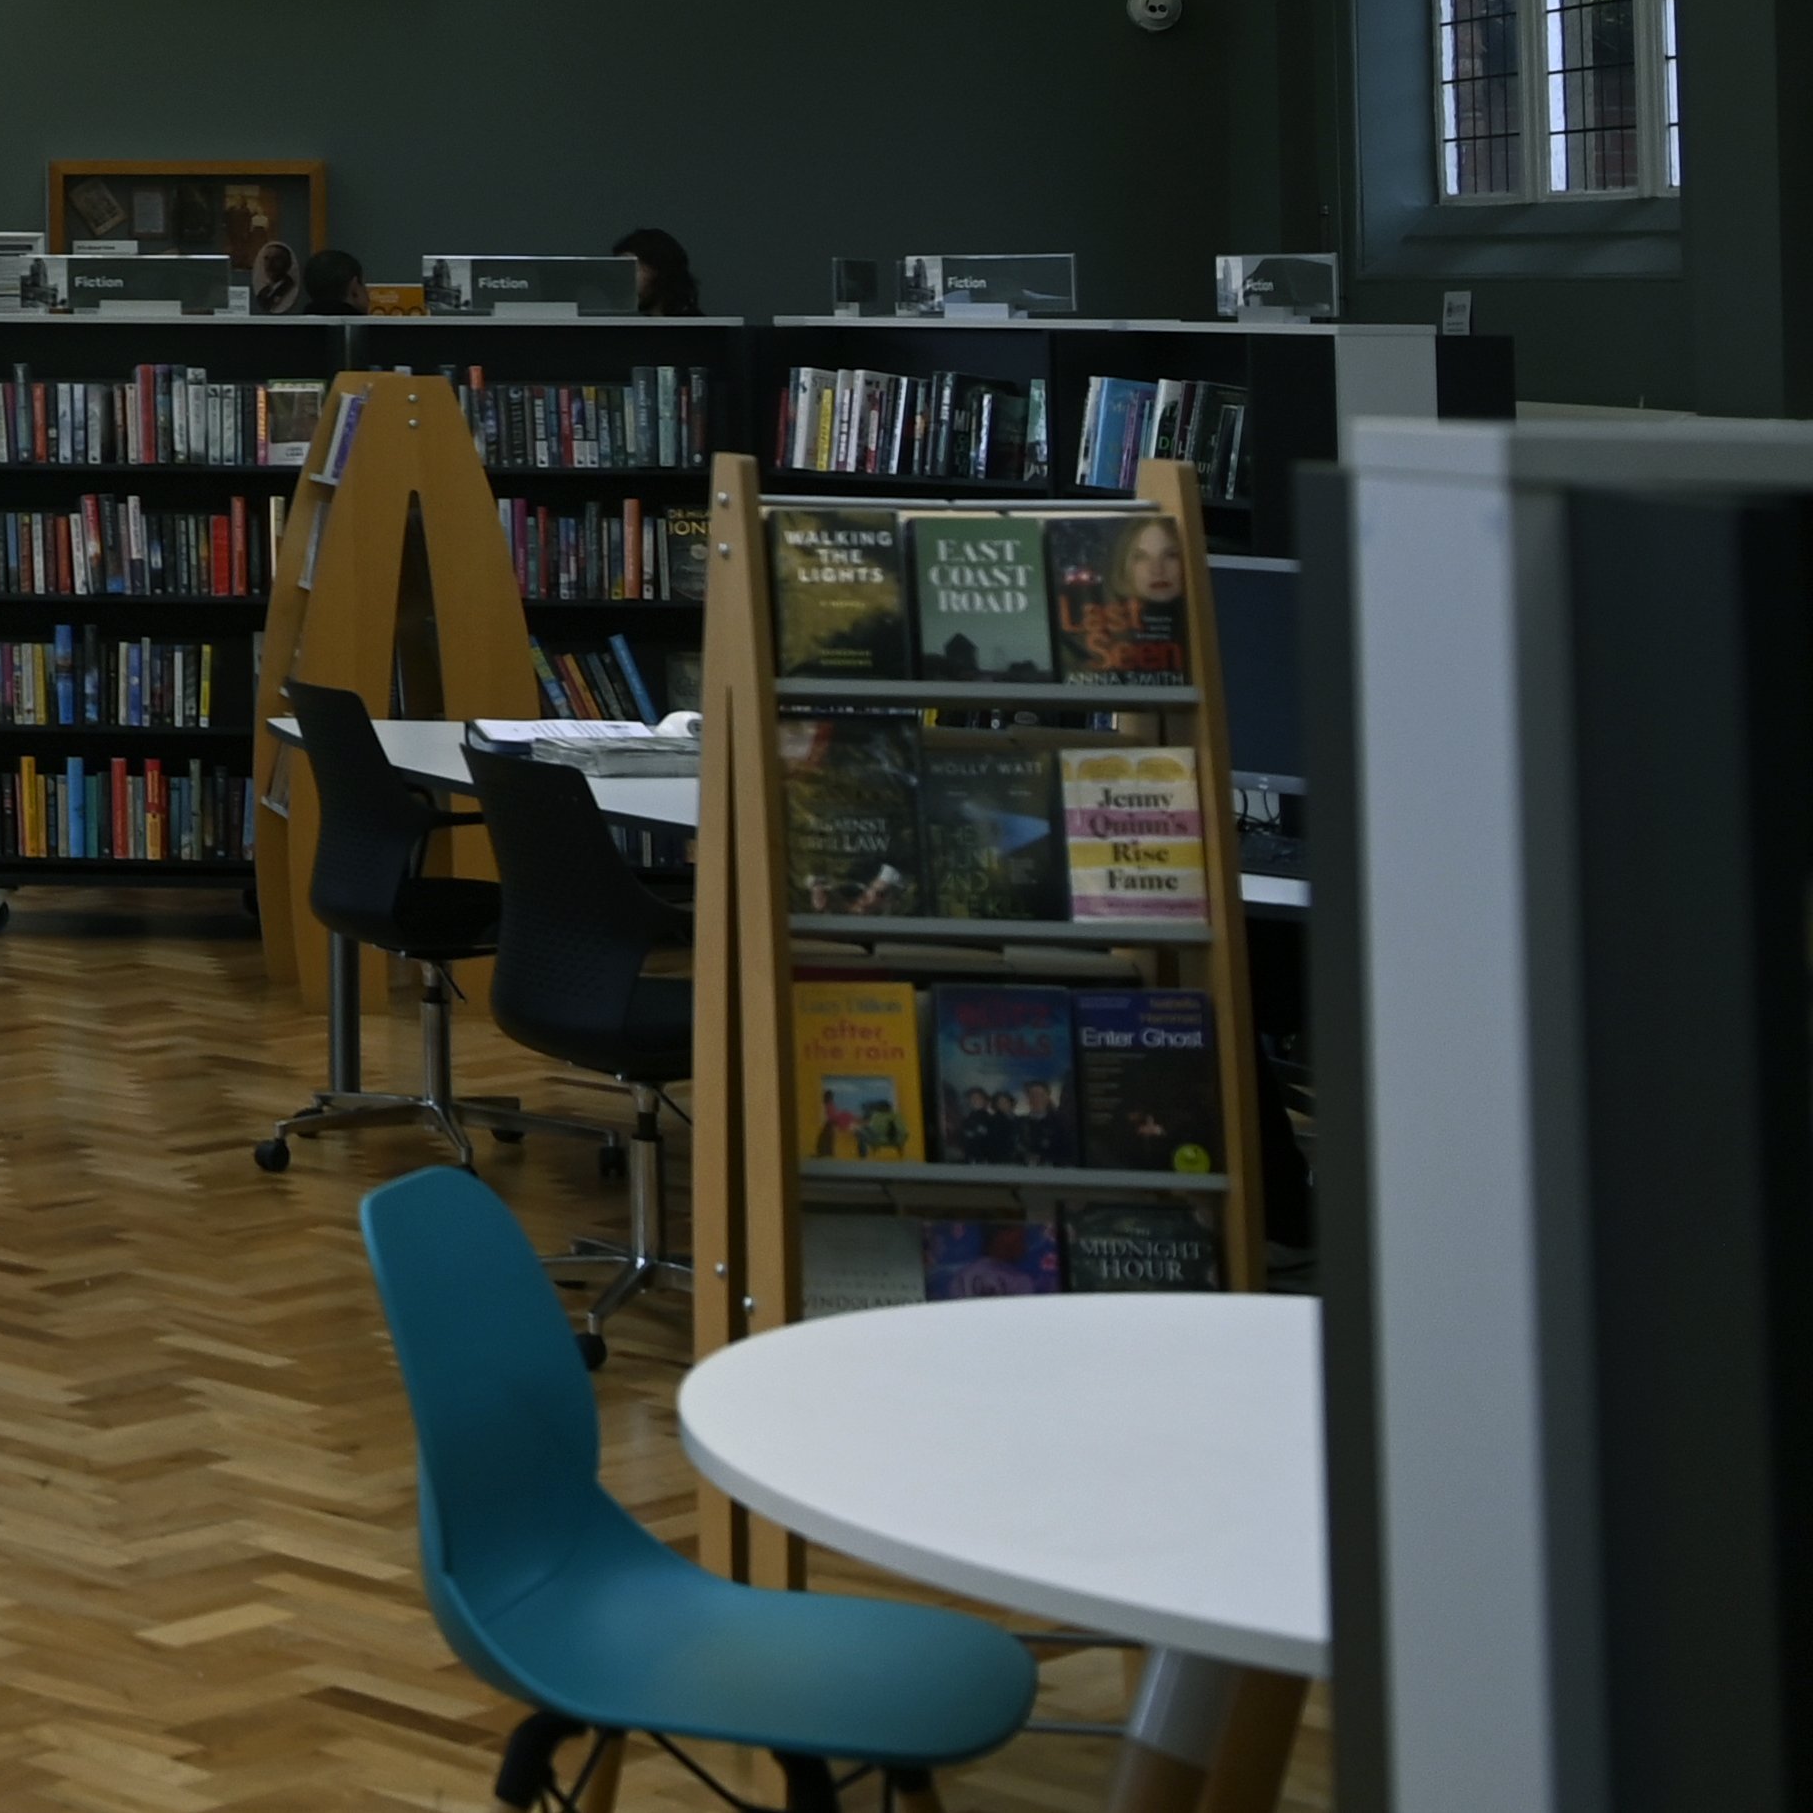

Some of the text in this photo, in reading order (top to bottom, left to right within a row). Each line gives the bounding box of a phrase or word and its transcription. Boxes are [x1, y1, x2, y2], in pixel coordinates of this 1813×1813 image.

[75, 274, 124, 289] Fiction
[478, 276, 529, 289] Fiction
[947, 276, 987, 289] Fiction
[1246, 279, 1274, 291] Fiction
[785, 530, 893, 546] WALKING
[817, 549, 864, 565] THE
[936, 540, 1021, 563] EAST
[796, 566, 885, 584] LIGHTS
[928, 566, 1034, 588] COAST
[936, 590, 1029, 614] ROAD
[1060, 593, 1144, 633] Last
[1089, 634, 1183, 670] Seen
[1064, 670, 1185, 686] ANNA SMITH
[930, 761, 1043, 775] HOLLY WATT
[1097, 788, 1174, 811] Jenny
[1089, 816, 1189, 840] Quinn's
[843, 834, 891, 853] LAW
[1113, 842, 1170, 864] Rise
[1106, 870, 1179, 891] Fame
[821, 1020, 881, 1043] after
[1081, 1026, 1204, 1048] Enter Ghost
[803, 1042, 905, 1062] the rain
[959, 1034, 1052, 1057] GIRLS
[1079, 1241, 1202, 1260] MIDNIGHT
[1101, 1258, 1185, 1282] HOUR
